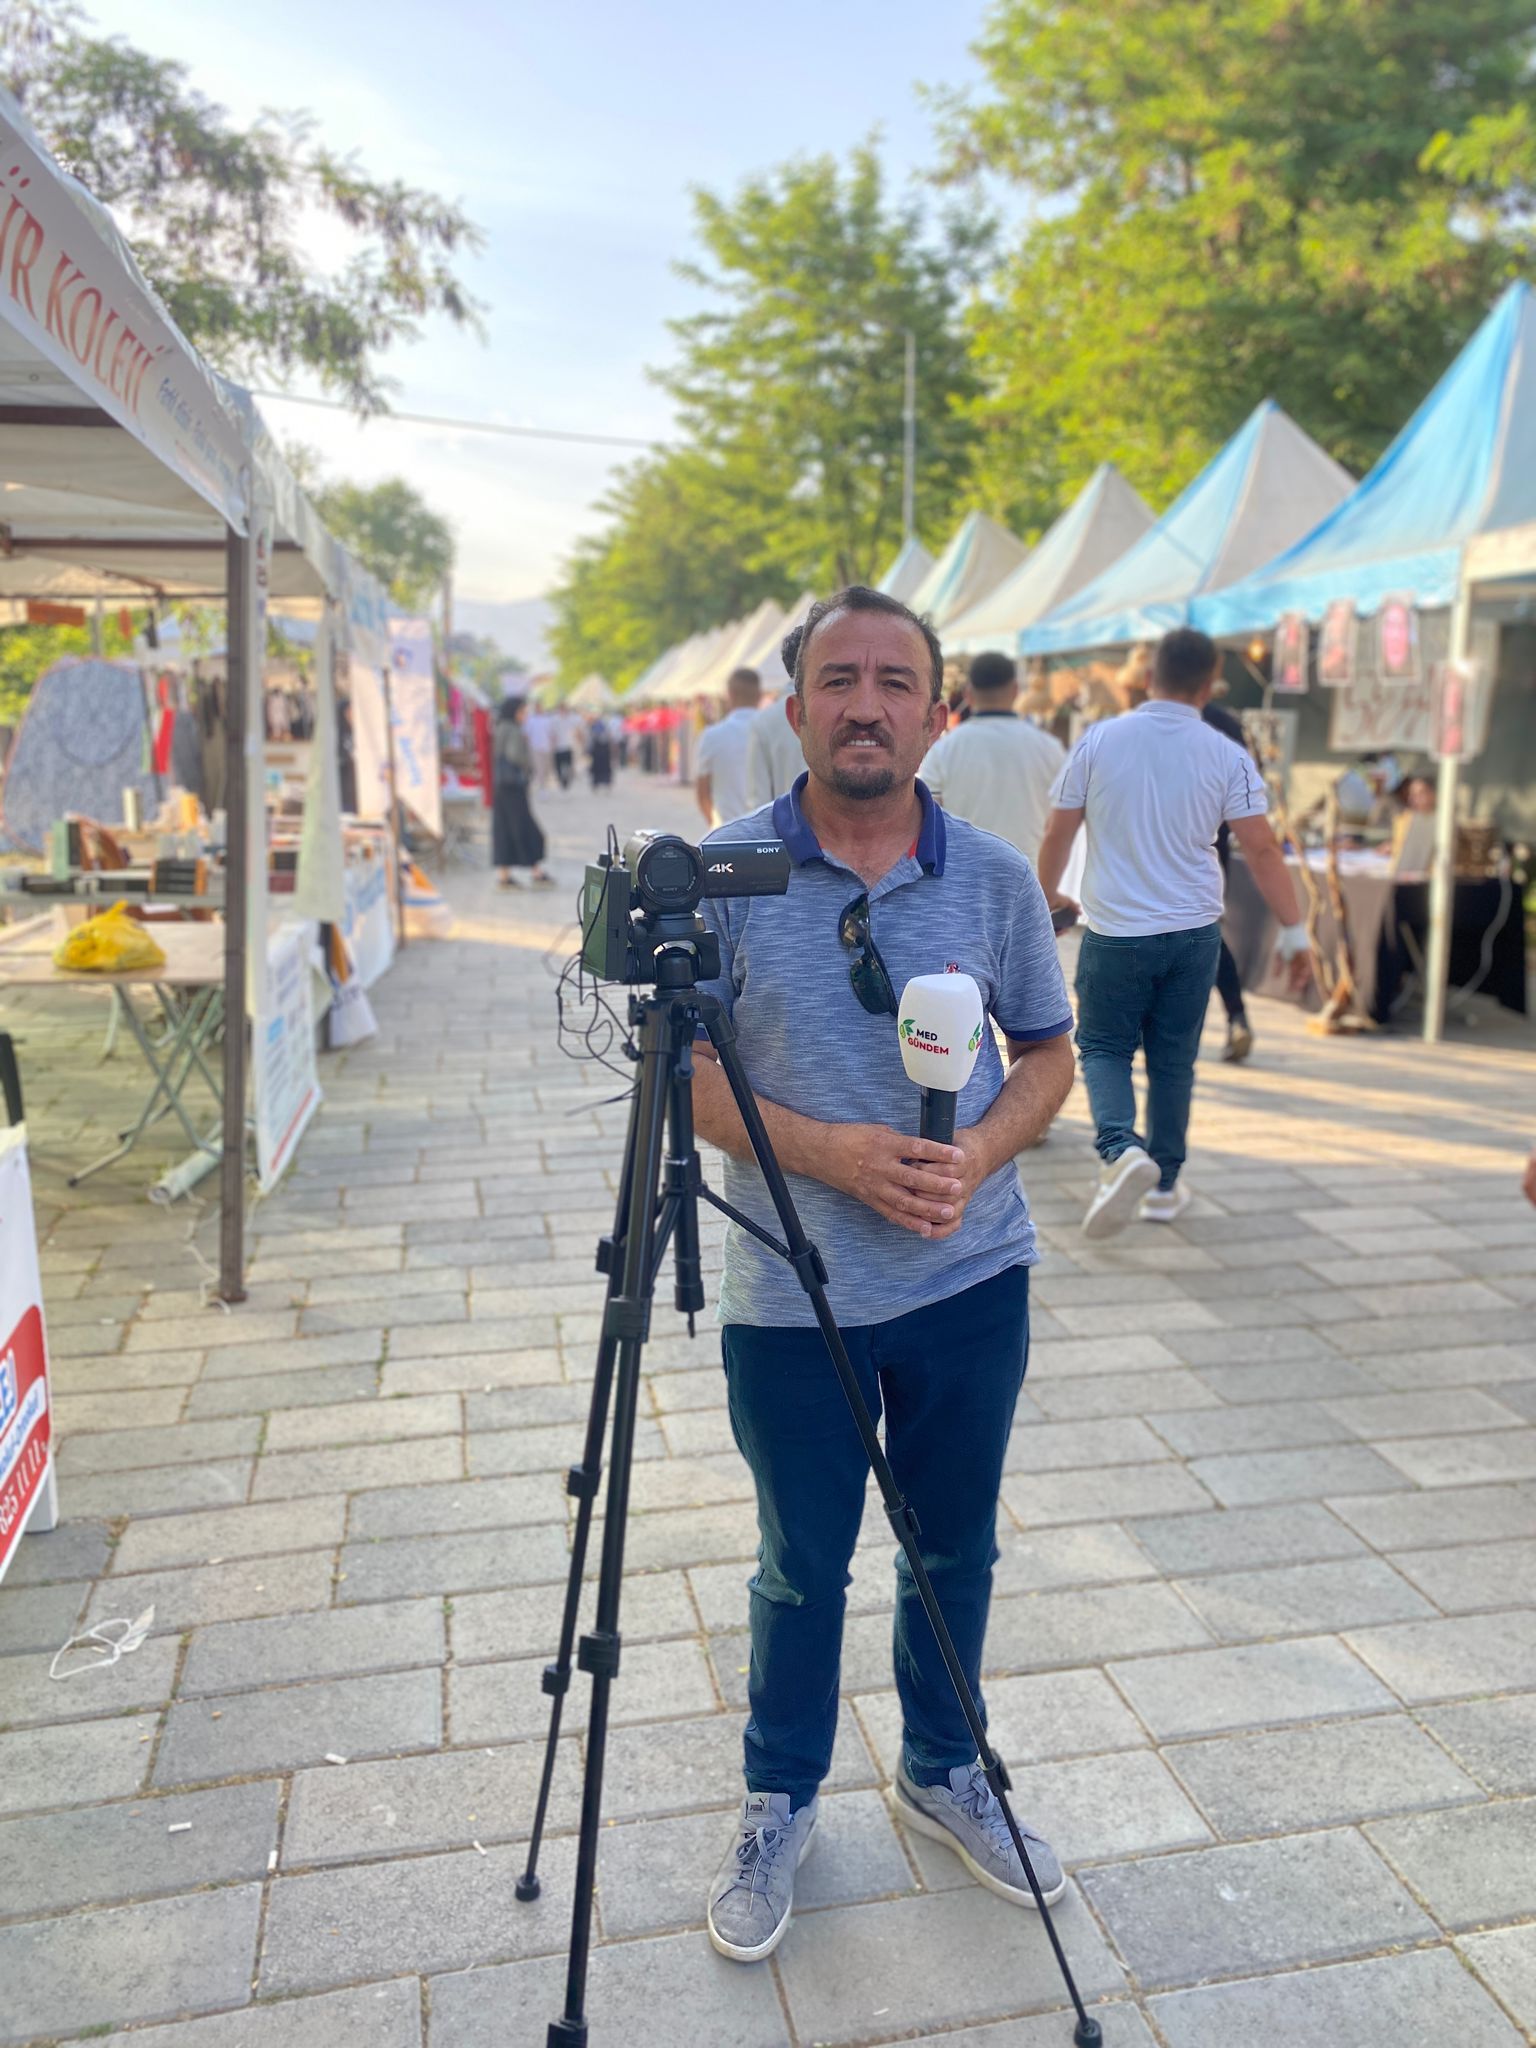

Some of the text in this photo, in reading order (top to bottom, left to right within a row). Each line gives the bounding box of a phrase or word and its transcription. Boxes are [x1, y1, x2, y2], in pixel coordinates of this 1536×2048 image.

[707, 862, 734, 873] 4K
[916, 1028, 938, 1041] MED
[907, 1037, 949, 1055] GÜNDEM
